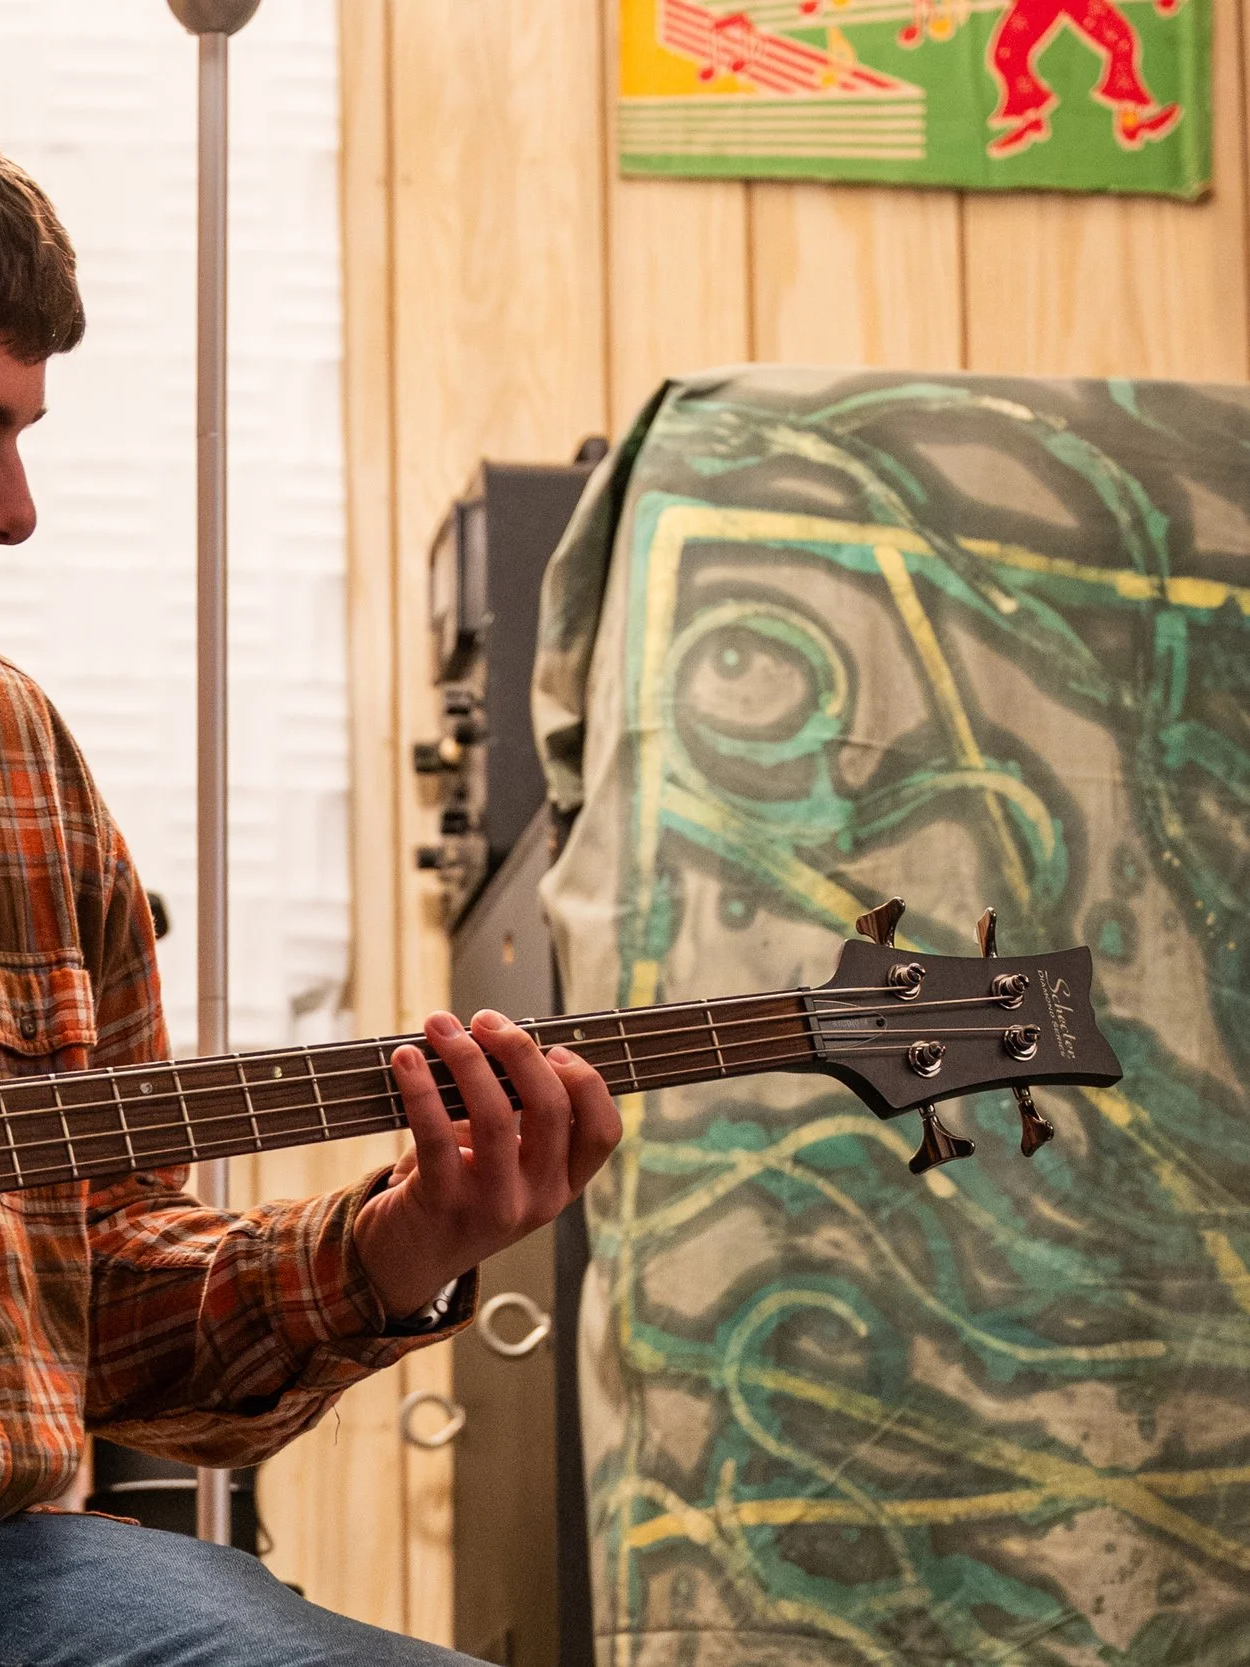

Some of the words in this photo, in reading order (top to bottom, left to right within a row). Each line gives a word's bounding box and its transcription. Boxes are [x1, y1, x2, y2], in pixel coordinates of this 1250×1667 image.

[1037, 969, 1055, 1019] DIAMOND
[1052, 1020, 1066, 1057] SERIES
[1044, 970, 1077, 1059] Schecter
